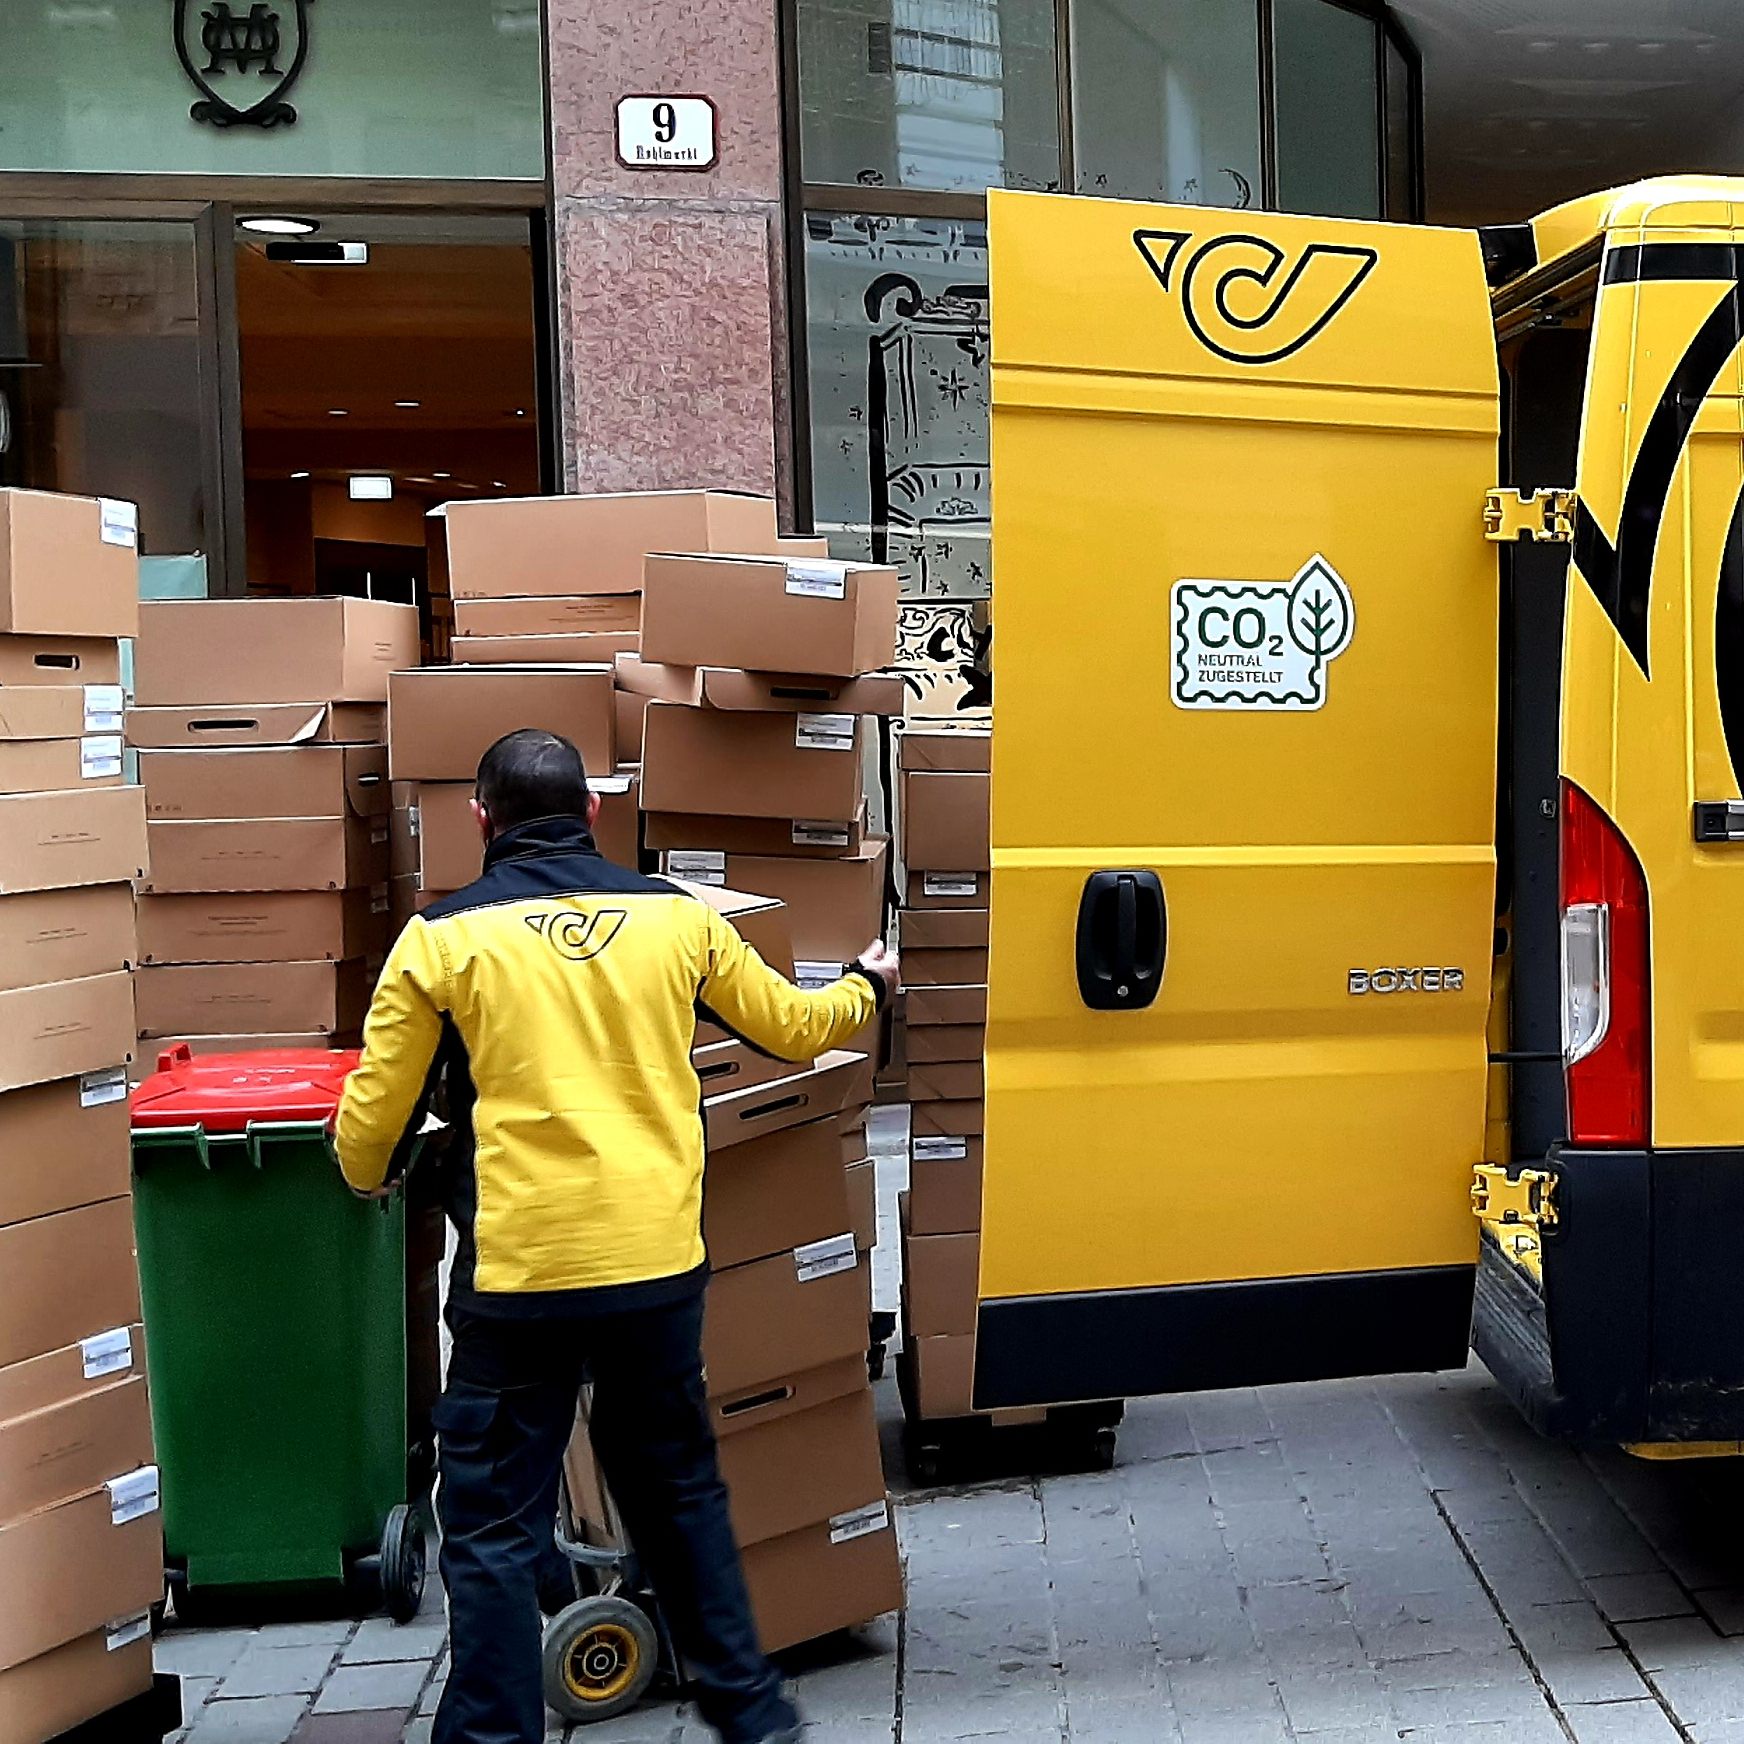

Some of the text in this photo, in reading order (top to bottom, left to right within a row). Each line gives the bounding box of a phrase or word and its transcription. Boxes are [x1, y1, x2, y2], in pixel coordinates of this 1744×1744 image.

[653, 103, 676, 142] 9
[1198, 654, 1262, 667] NEUTRAL
[1198, 670, 1284, 683] ZUGESTELLT
[1348, 966, 1465, 994] BOXER
